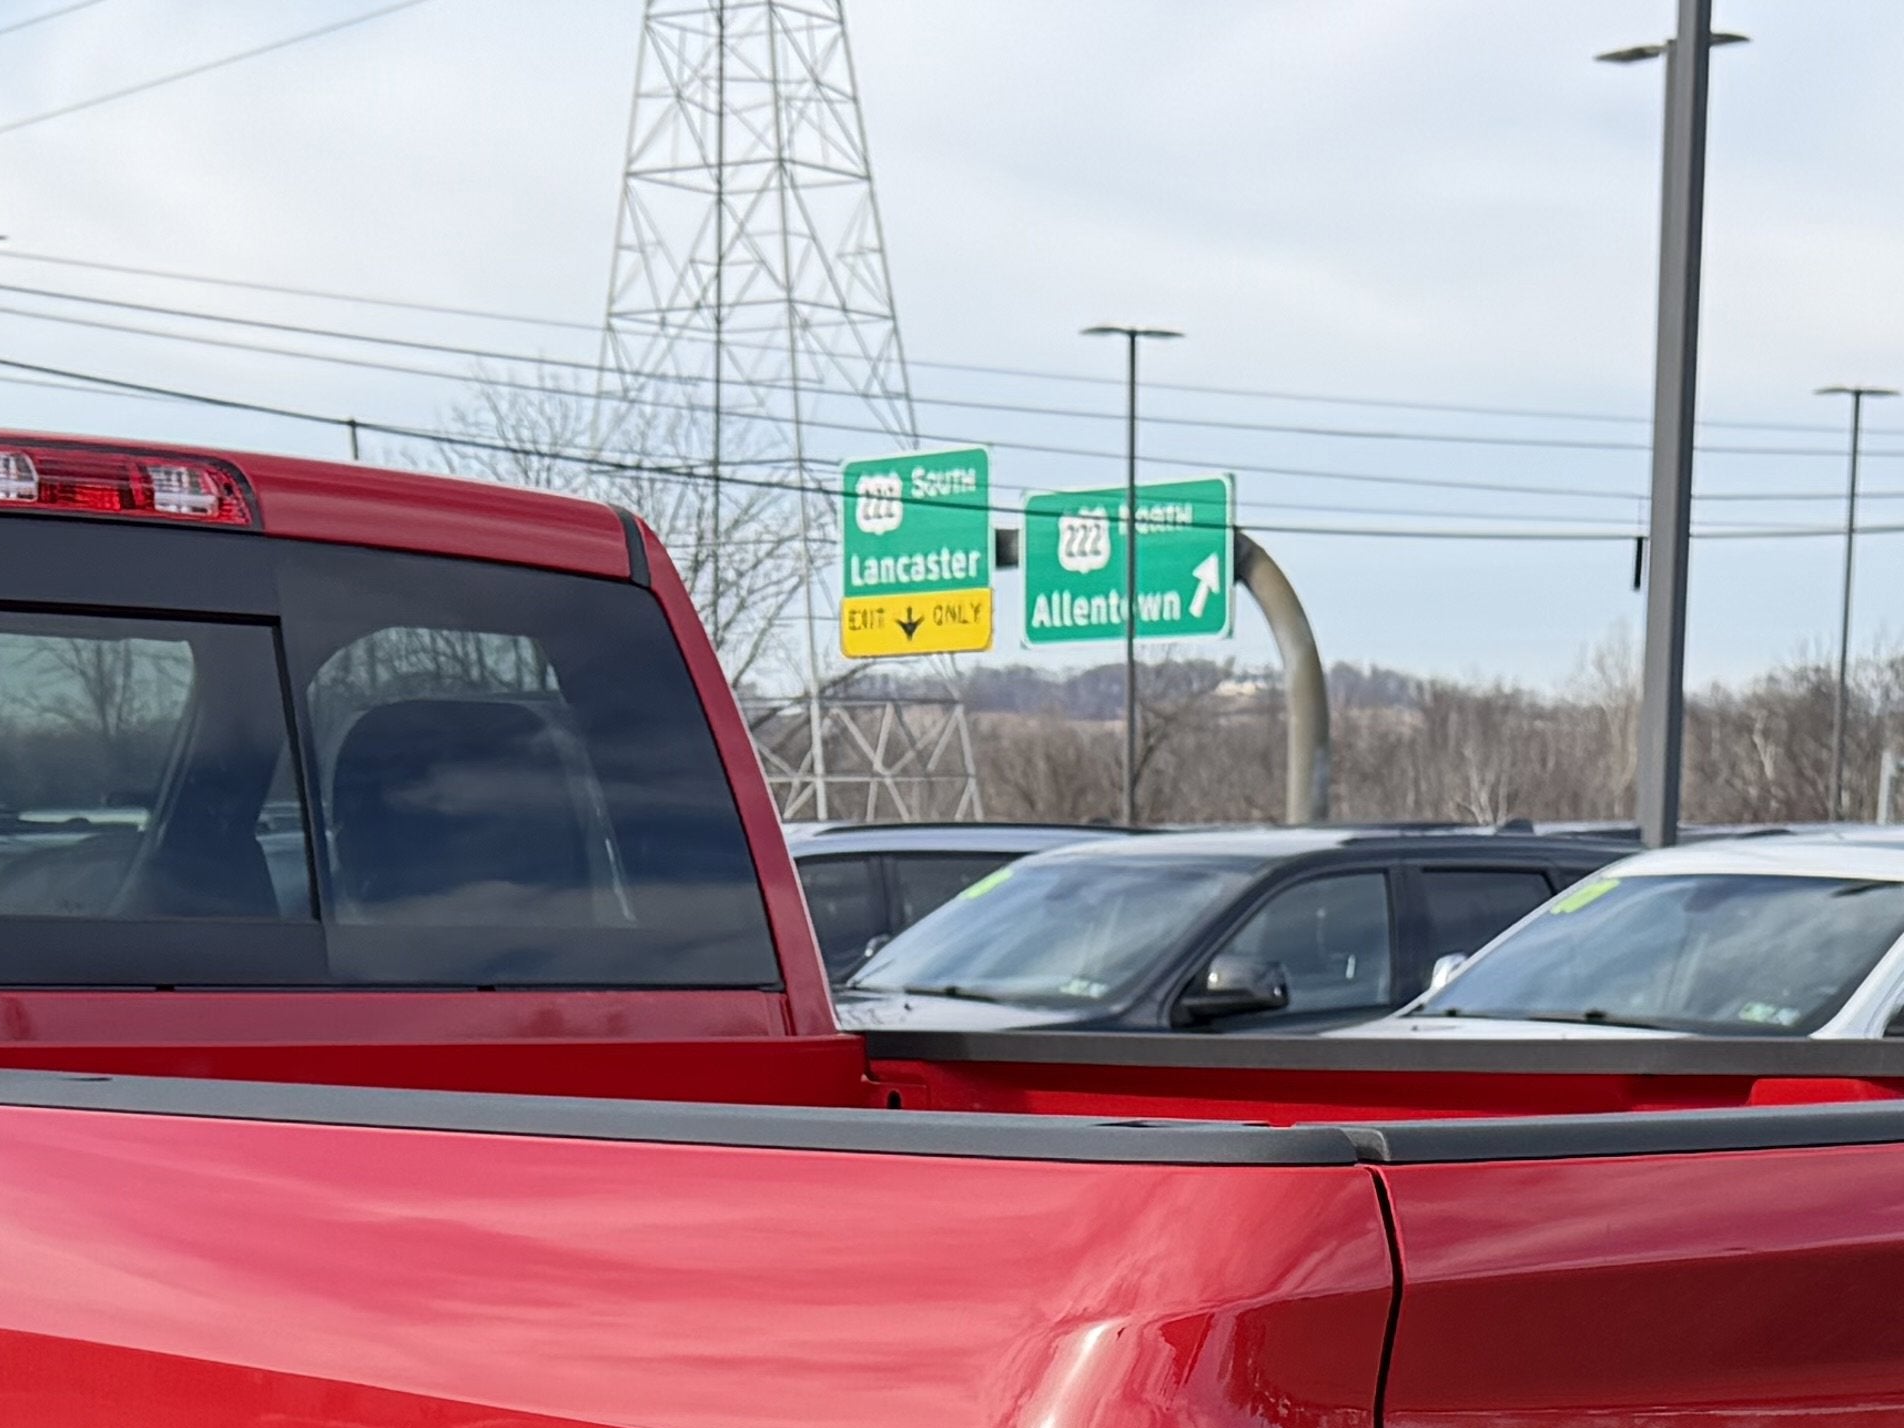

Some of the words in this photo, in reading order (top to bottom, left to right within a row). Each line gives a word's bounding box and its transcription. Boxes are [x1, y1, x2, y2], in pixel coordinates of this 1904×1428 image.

[1065, 523, 1102, 557] 222
[850, 547, 981, 586] Lancaster
[849, 607, 886, 631] EXIT
[933, 602, 983, 626] ONLY
